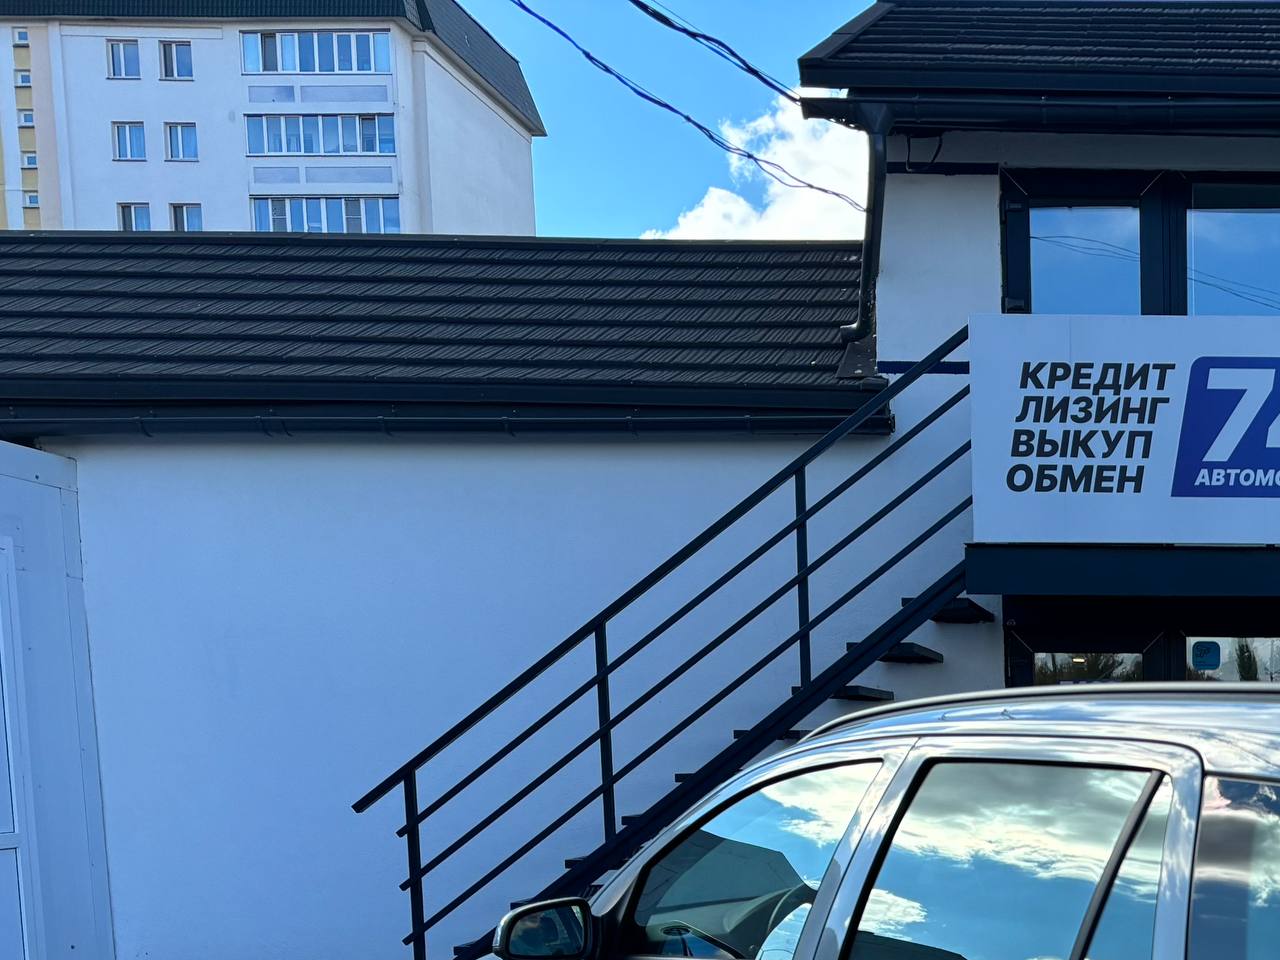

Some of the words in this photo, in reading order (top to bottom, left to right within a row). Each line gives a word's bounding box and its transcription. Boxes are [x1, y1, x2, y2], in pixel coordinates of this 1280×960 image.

[1019, 361, 1176, 396] КРЕДИТ
[1015, 395, 1170, 424] ЛИЗИНГ
[1010, 429, 1153, 459] ВЫКУП
[1006, 463, 1145, 493] ОБМЕН
